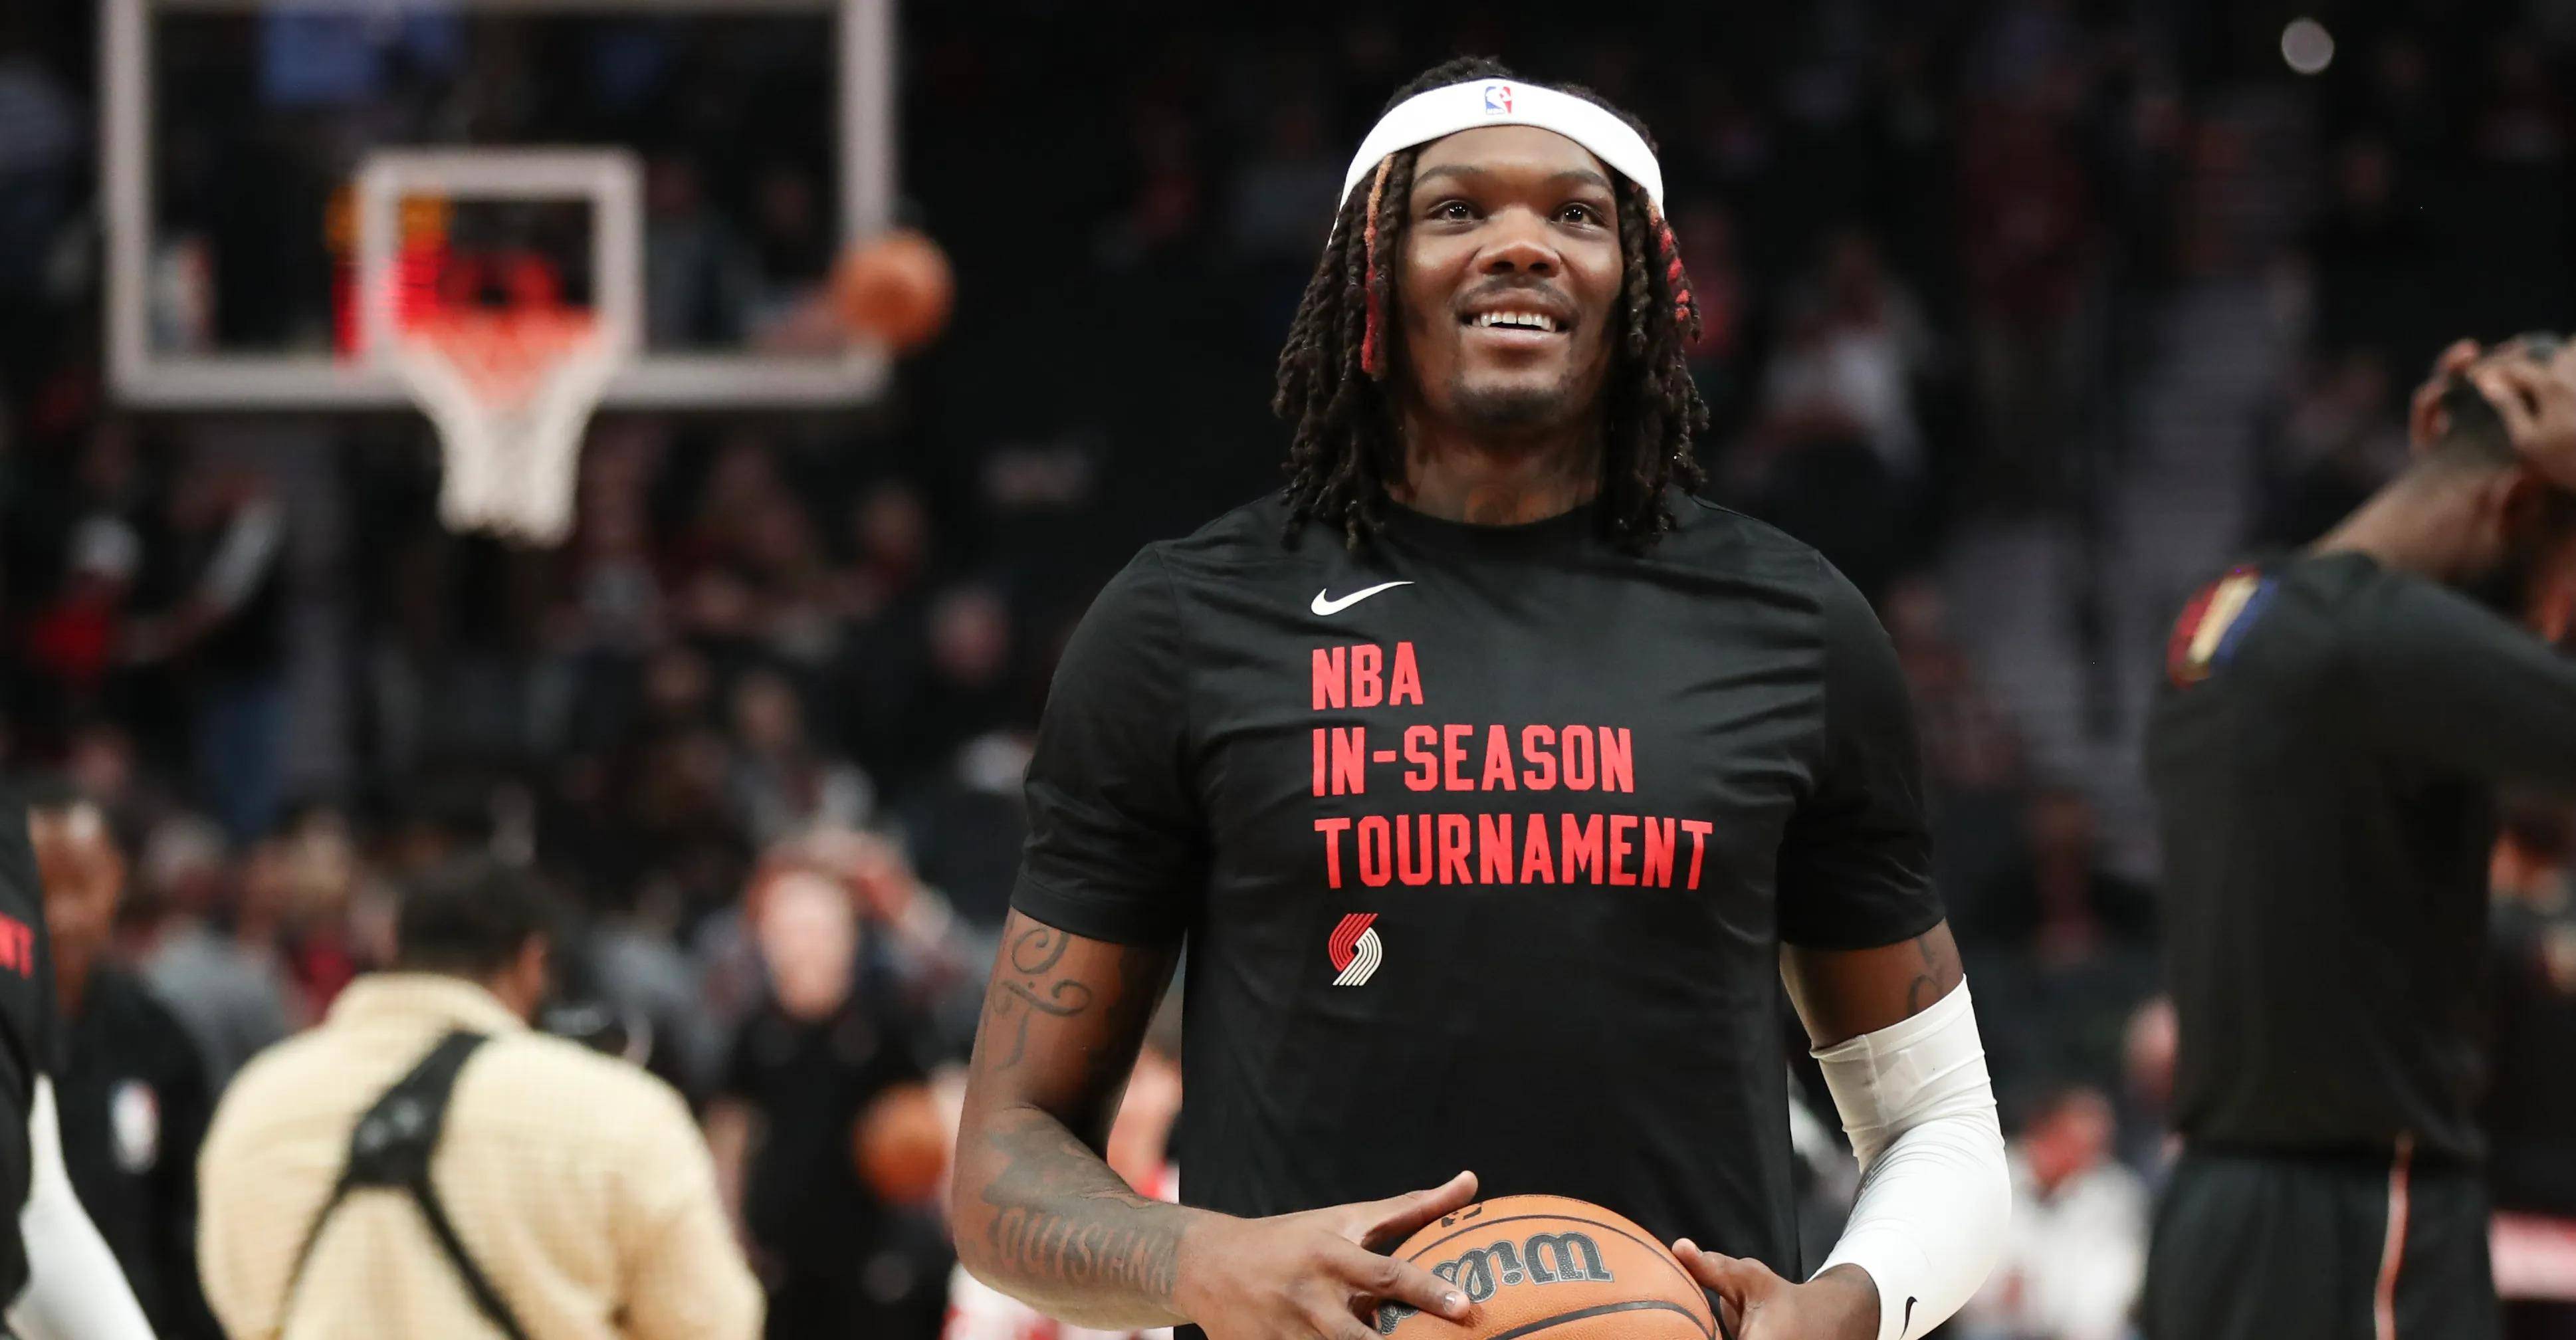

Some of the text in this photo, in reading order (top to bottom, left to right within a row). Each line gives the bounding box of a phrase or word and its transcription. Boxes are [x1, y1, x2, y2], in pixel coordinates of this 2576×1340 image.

[1312, 641, 1424, 711] NBA
[1312, 724, 1634, 797] IN-SEASON
[1314, 813, 1713, 891] TOURNAMENT
